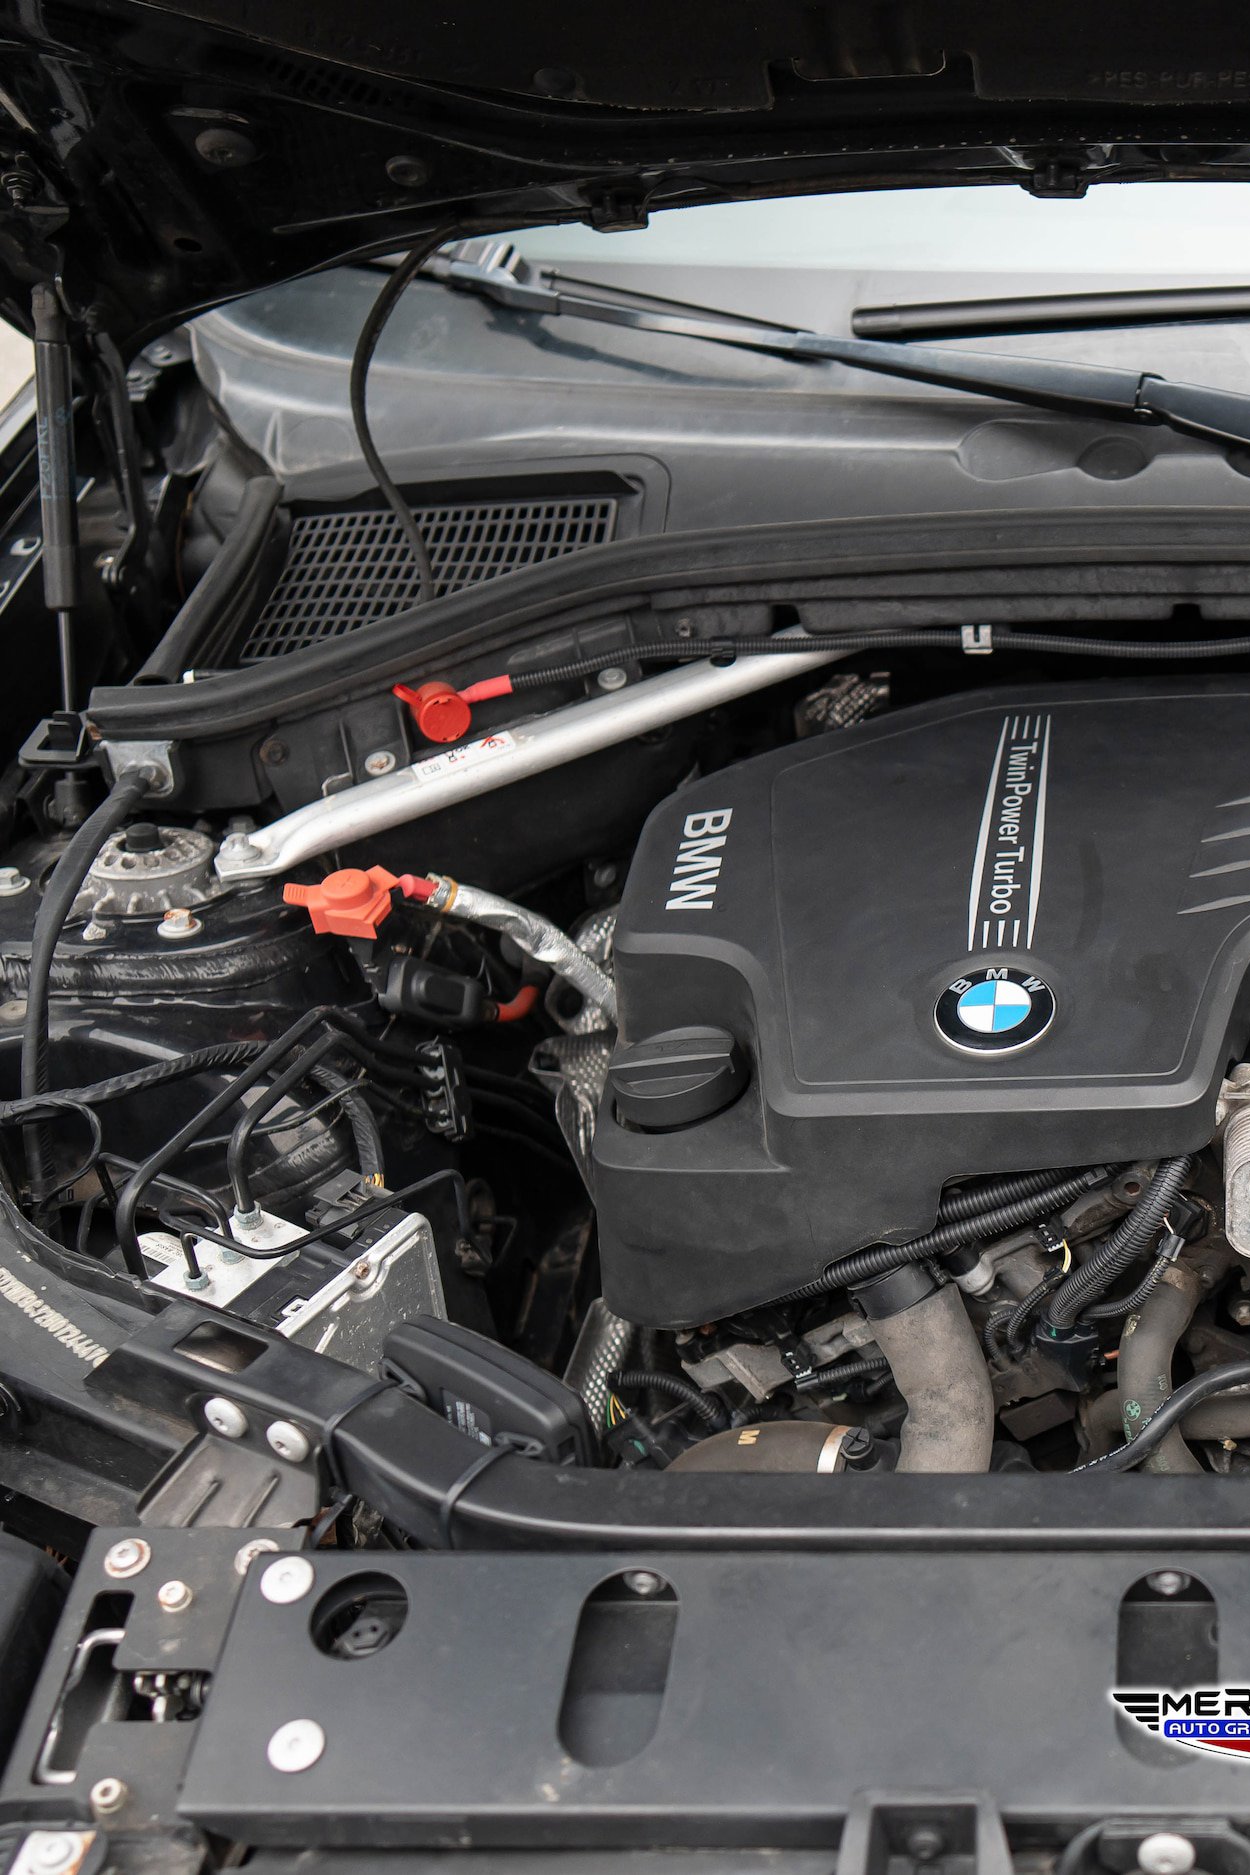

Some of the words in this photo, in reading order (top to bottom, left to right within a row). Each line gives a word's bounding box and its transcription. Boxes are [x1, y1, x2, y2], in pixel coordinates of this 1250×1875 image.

[998, 741, 1038, 844] TwinPower
[665, 807, 734, 911] BMW
[989, 846, 1025, 915] Turbo
[948, 968, 1046, 995] BMW
